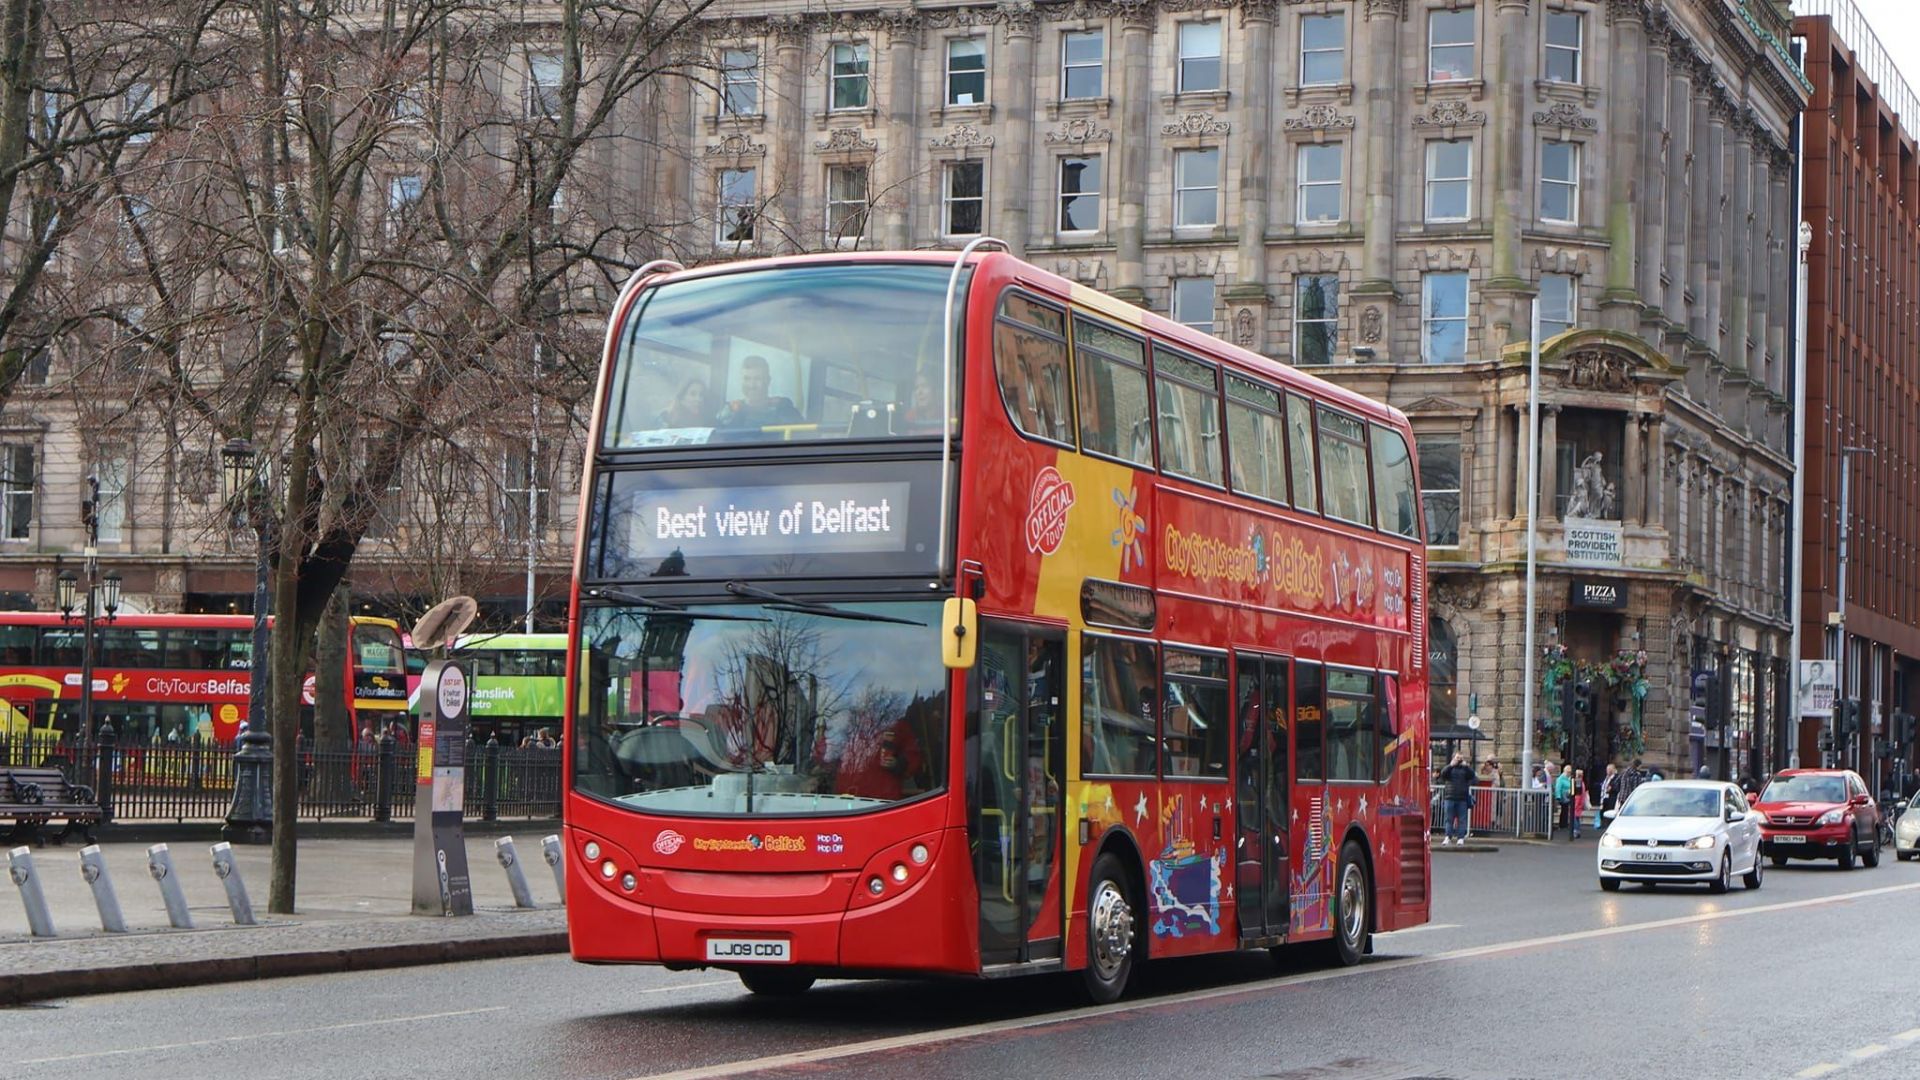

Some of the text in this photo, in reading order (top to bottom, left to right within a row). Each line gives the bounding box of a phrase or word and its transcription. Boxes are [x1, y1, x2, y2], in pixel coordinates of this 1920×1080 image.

[656, 499, 890, 538] Best view of Belfast
[1031, 486, 1072, 540] OFFICIAL
[1045, 519, 1065, 546] TOUR
[1571, 530, 1615, 541] SCOTTISH
[1568, 540, 1618, 551] PROVIDENT
[1566, 549, 1620, 561] INSTITUTION
[1272, 531, 1325, 598] Belfast
[1584, 585, 1617, 597] PIZZA
[146, 679, 251, 696] CityToursBelfas
[764, 834, 806, 852] Belfast
[817, 834, 831, 843] Hop
[832, 833, 843, 842] On
[817, 844, 844, 853] Hop Off
[1653, 852, 1668, 860] ZVA
[714, 943, 783, 956] LJ09 CDO
